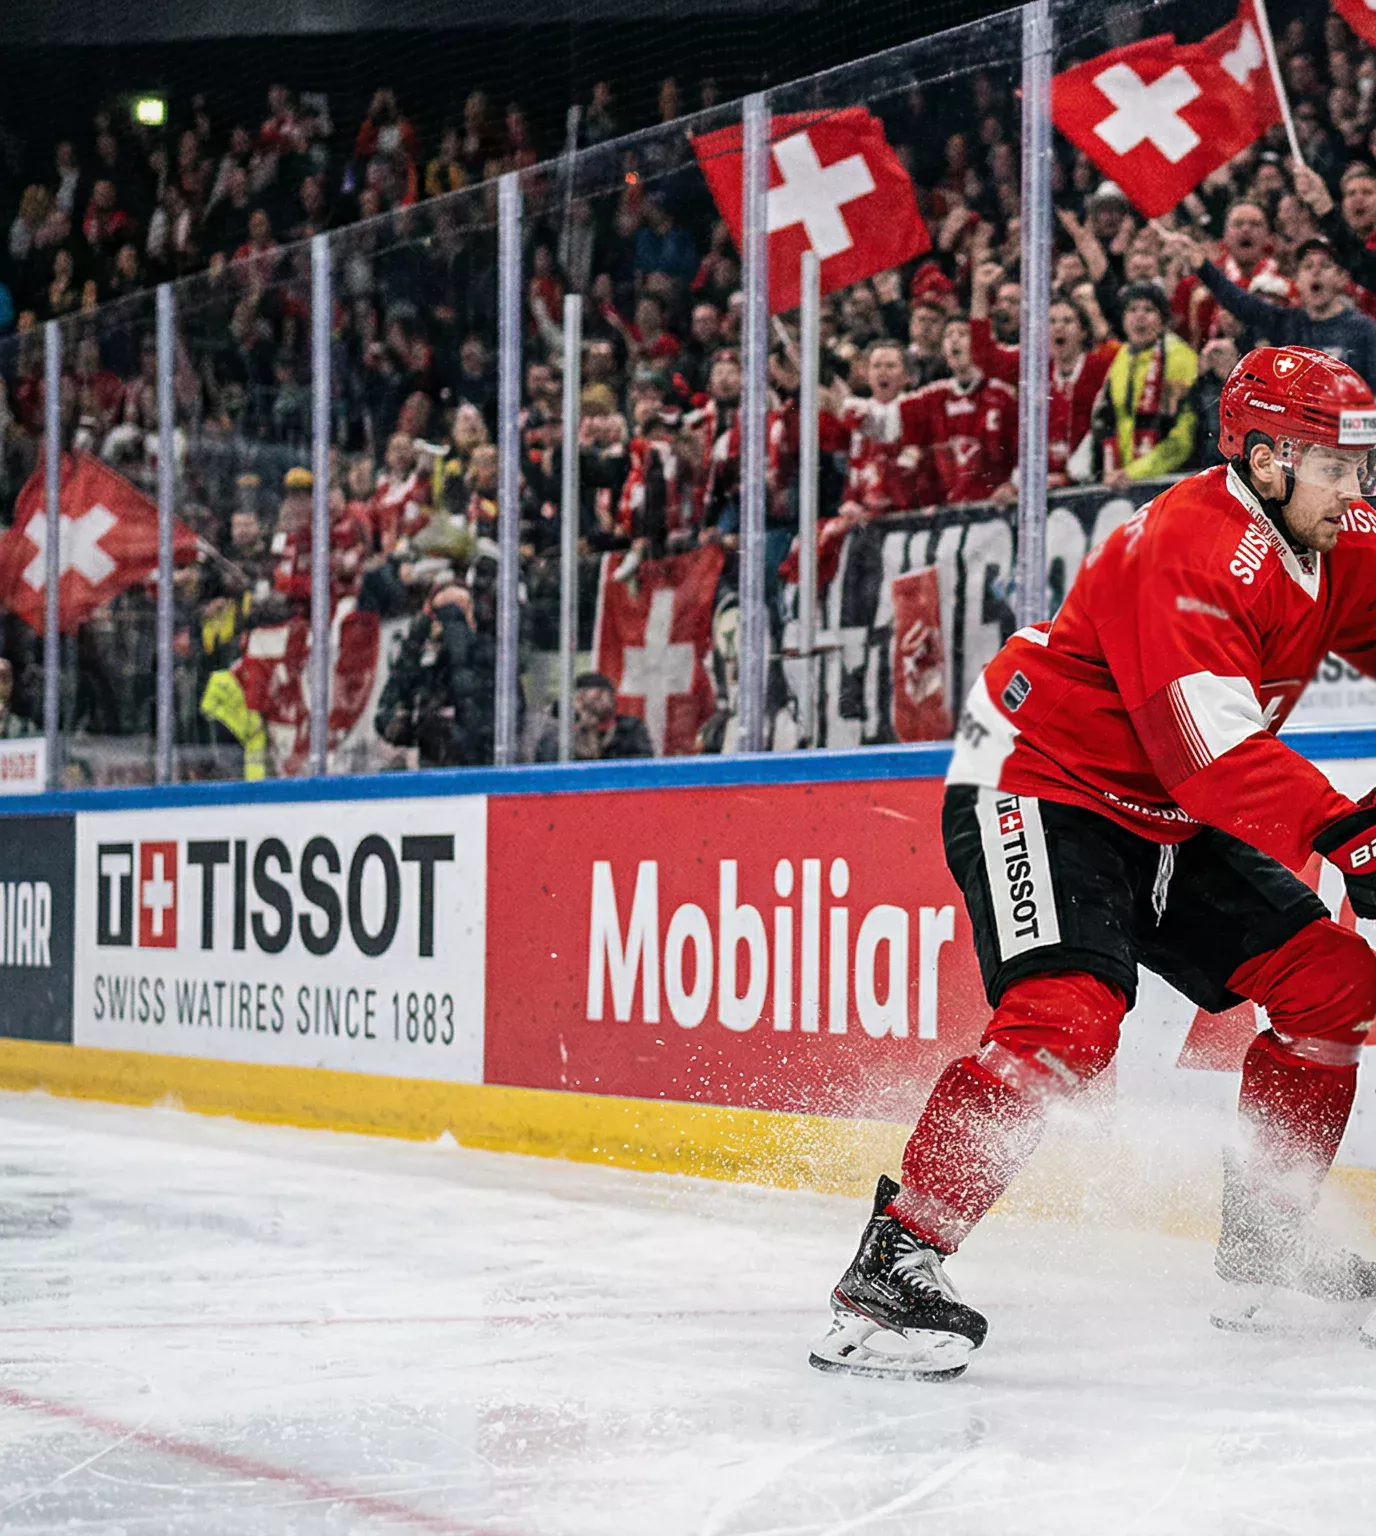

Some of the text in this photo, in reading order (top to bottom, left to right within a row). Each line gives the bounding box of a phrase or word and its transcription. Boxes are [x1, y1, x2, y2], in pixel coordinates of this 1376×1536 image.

[187, 834, 455, 957] TISSOT
[1003, 831, 1039, 939] TISSOT
[586, 857, 955, 1040] Mobiliar
[94, 974, 455, 1045] SWISS WATIRES SINCE 1883
